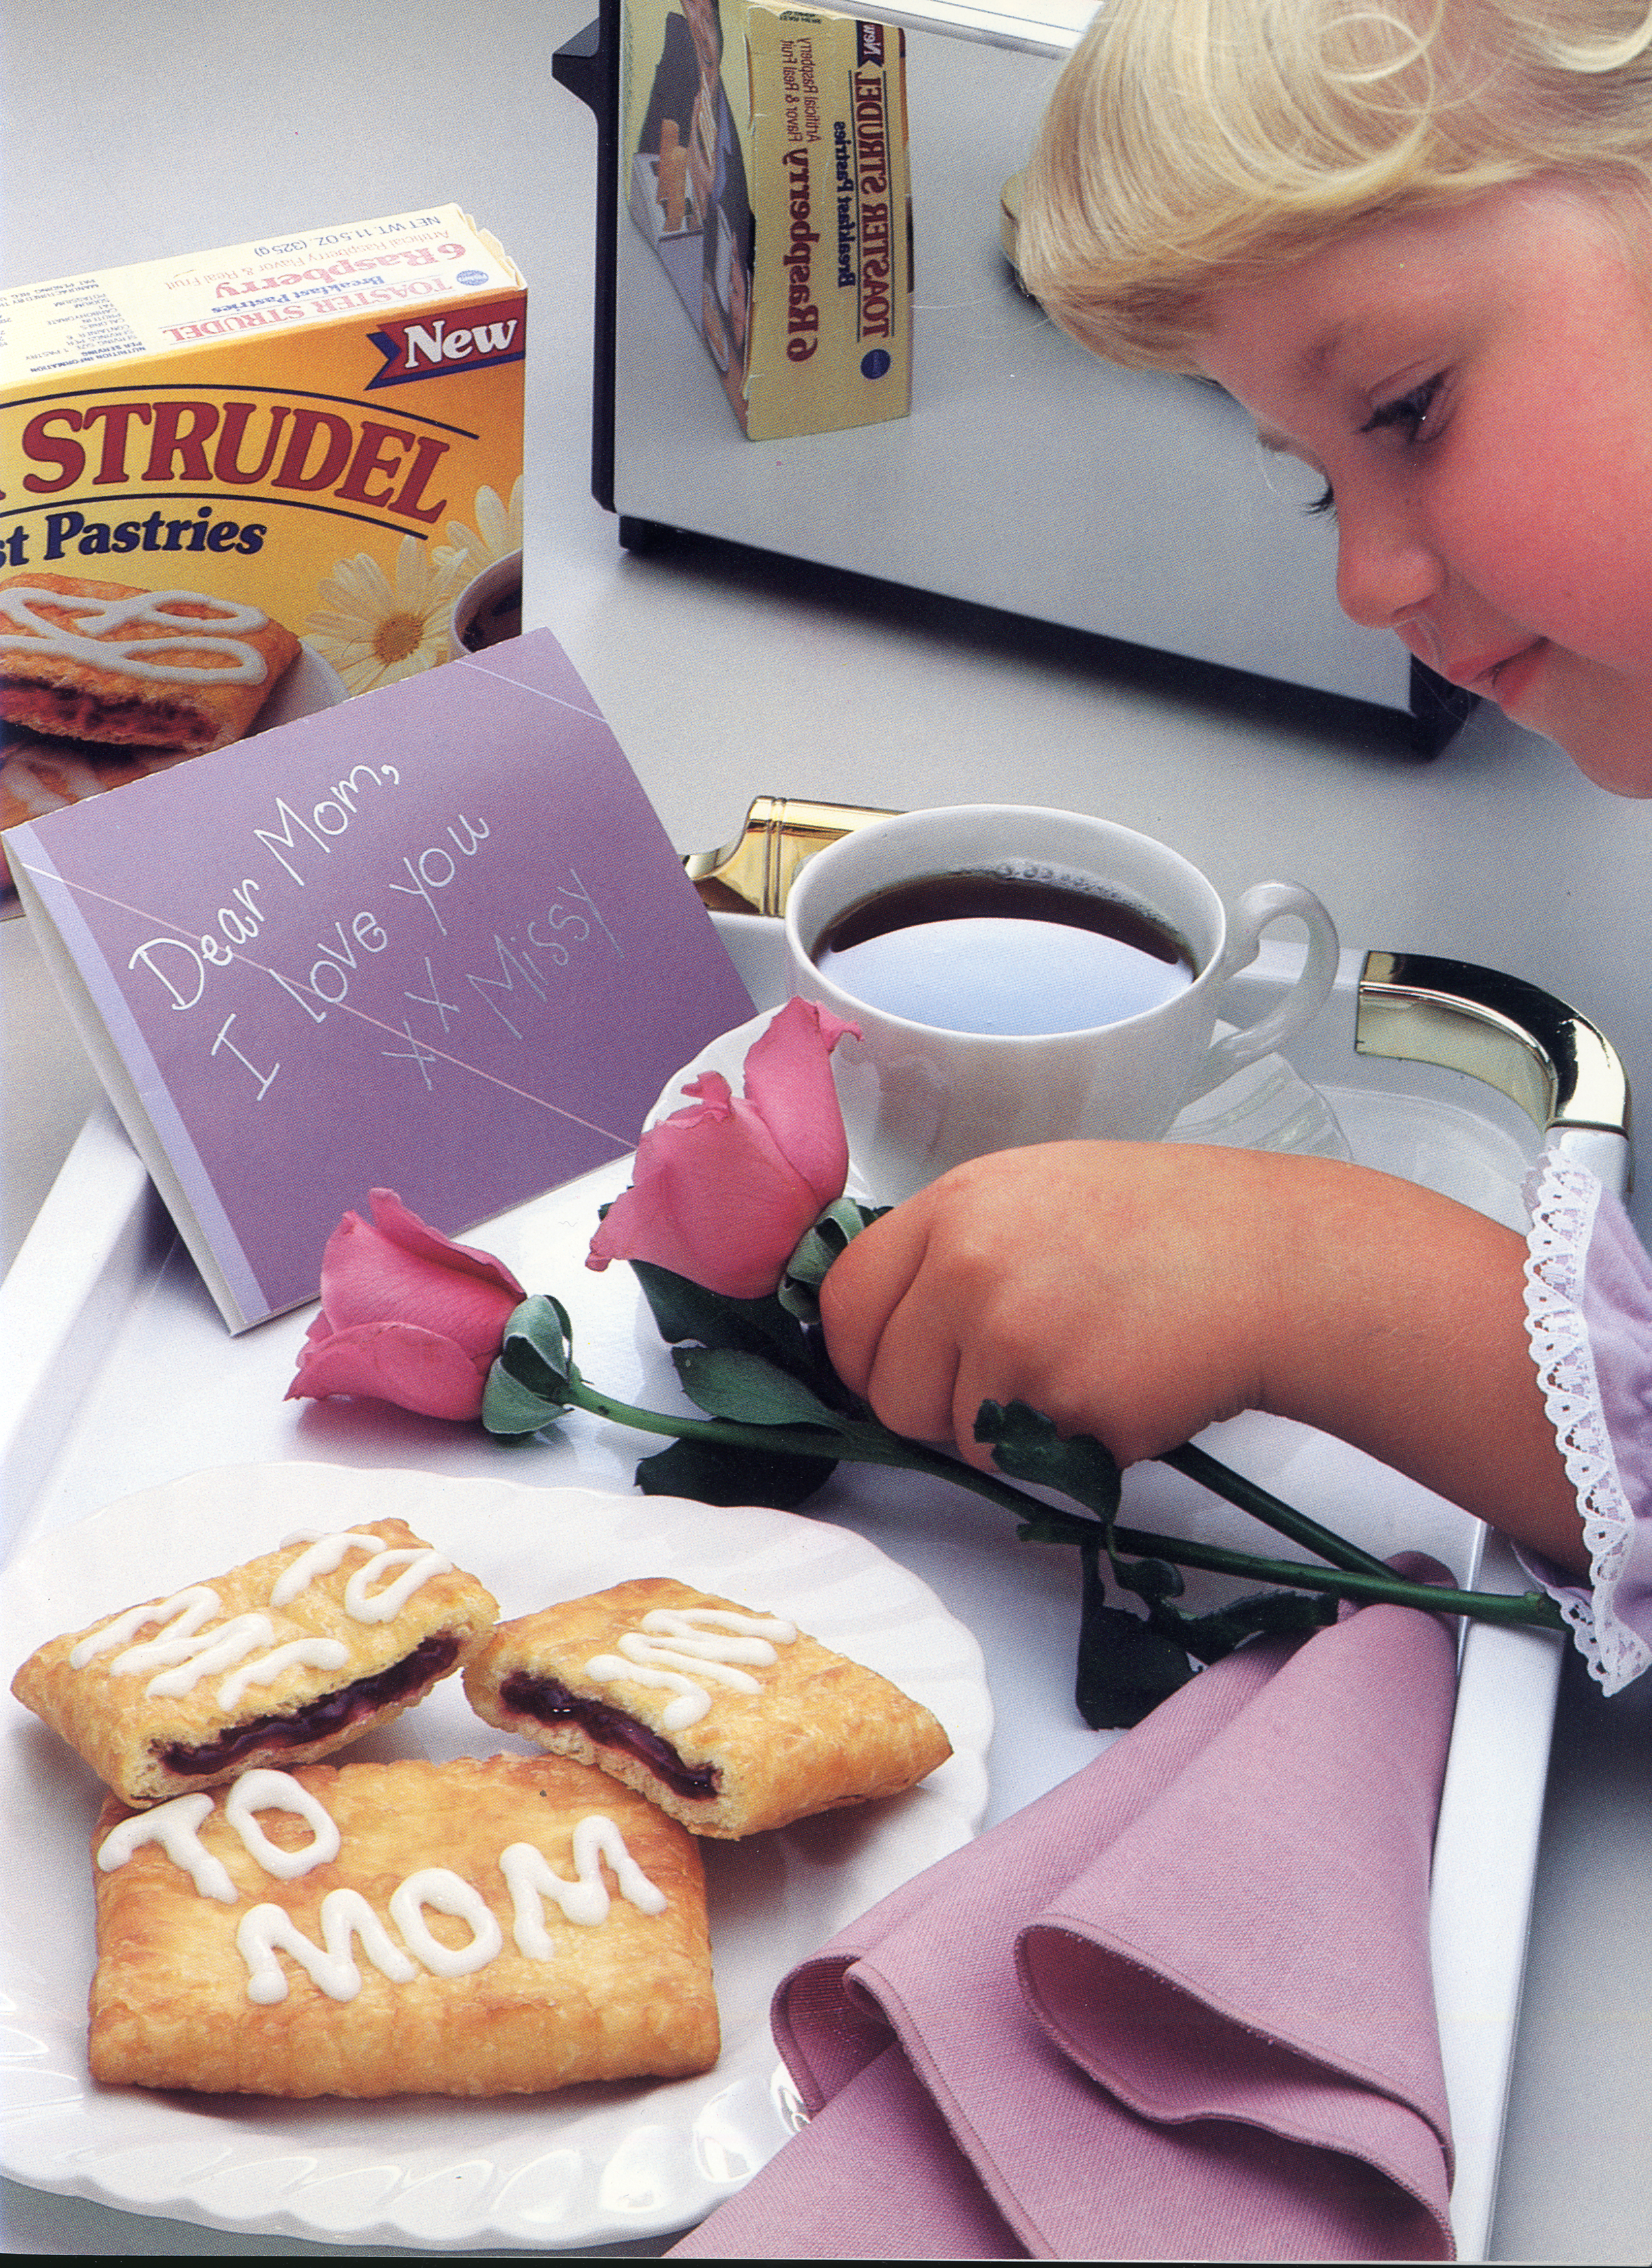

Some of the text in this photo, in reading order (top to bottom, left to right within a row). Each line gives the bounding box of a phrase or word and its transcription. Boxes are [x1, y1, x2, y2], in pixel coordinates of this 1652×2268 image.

[409, 216, 442, 229] NET
[164, 229, 449, 291] Artificial Raspberry Flavor & Real Fruit
[215, 248, 438, 298] Raspberry
[438, 243, 466, 261] 6
[210, 275, 384, 315] Breakfast Pastries
[309, 276, 453, 315] TOASTER
[162, 303, 304, 342] STRUDEL
[404, 319, 518, 369] New
[22, 402, 449, 523] STRUDEL
[44, 506, 266, 560] Pastries
[128, 761, 400, 1011] Dear Mom,
[466, 866, 626, 1040] Missy
[210, 1013, 280, 1102] I
[97, 1768, 341, 1904] TO
[235, 1814, 669, 2007] MOM
